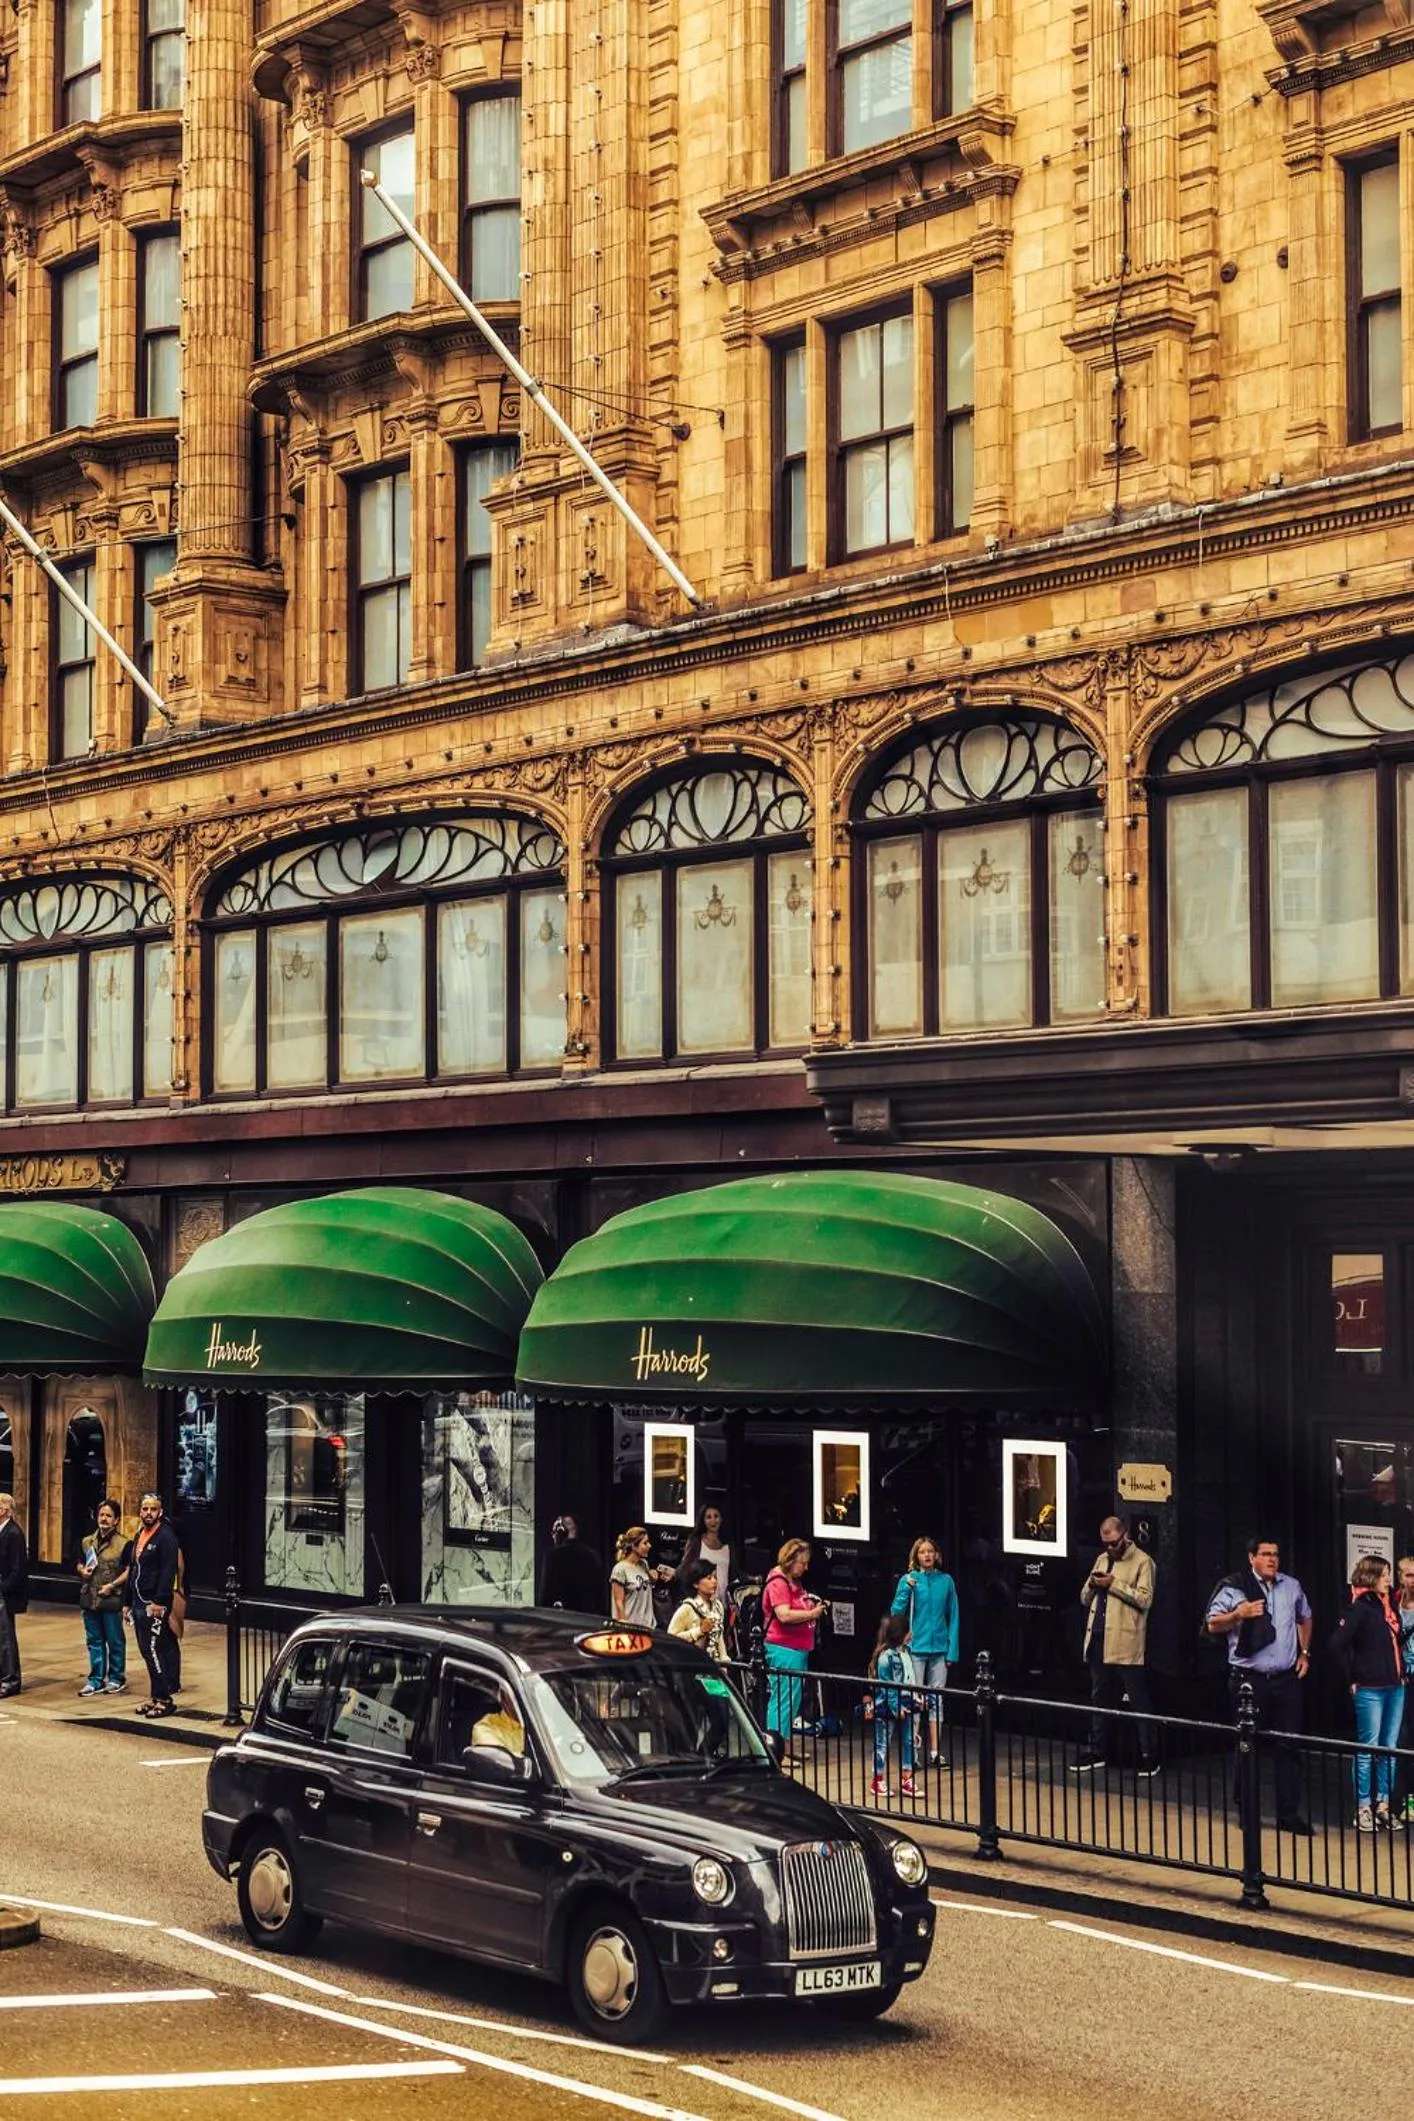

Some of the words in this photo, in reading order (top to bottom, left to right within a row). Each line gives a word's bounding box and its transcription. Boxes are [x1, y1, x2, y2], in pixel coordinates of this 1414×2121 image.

[203, 1322, 262, 1369] Harrods
[630, 1326, 711, 1382] Harrods
[1128, 1474, 1157, 1492] Harrods
[1138, 1520, 1149, 1542] 8
[606, 1634, 645, 1651] TAXI
[802, 1968, 843, 1990] LL63
[848, 1964, 875, 1986] MTK
